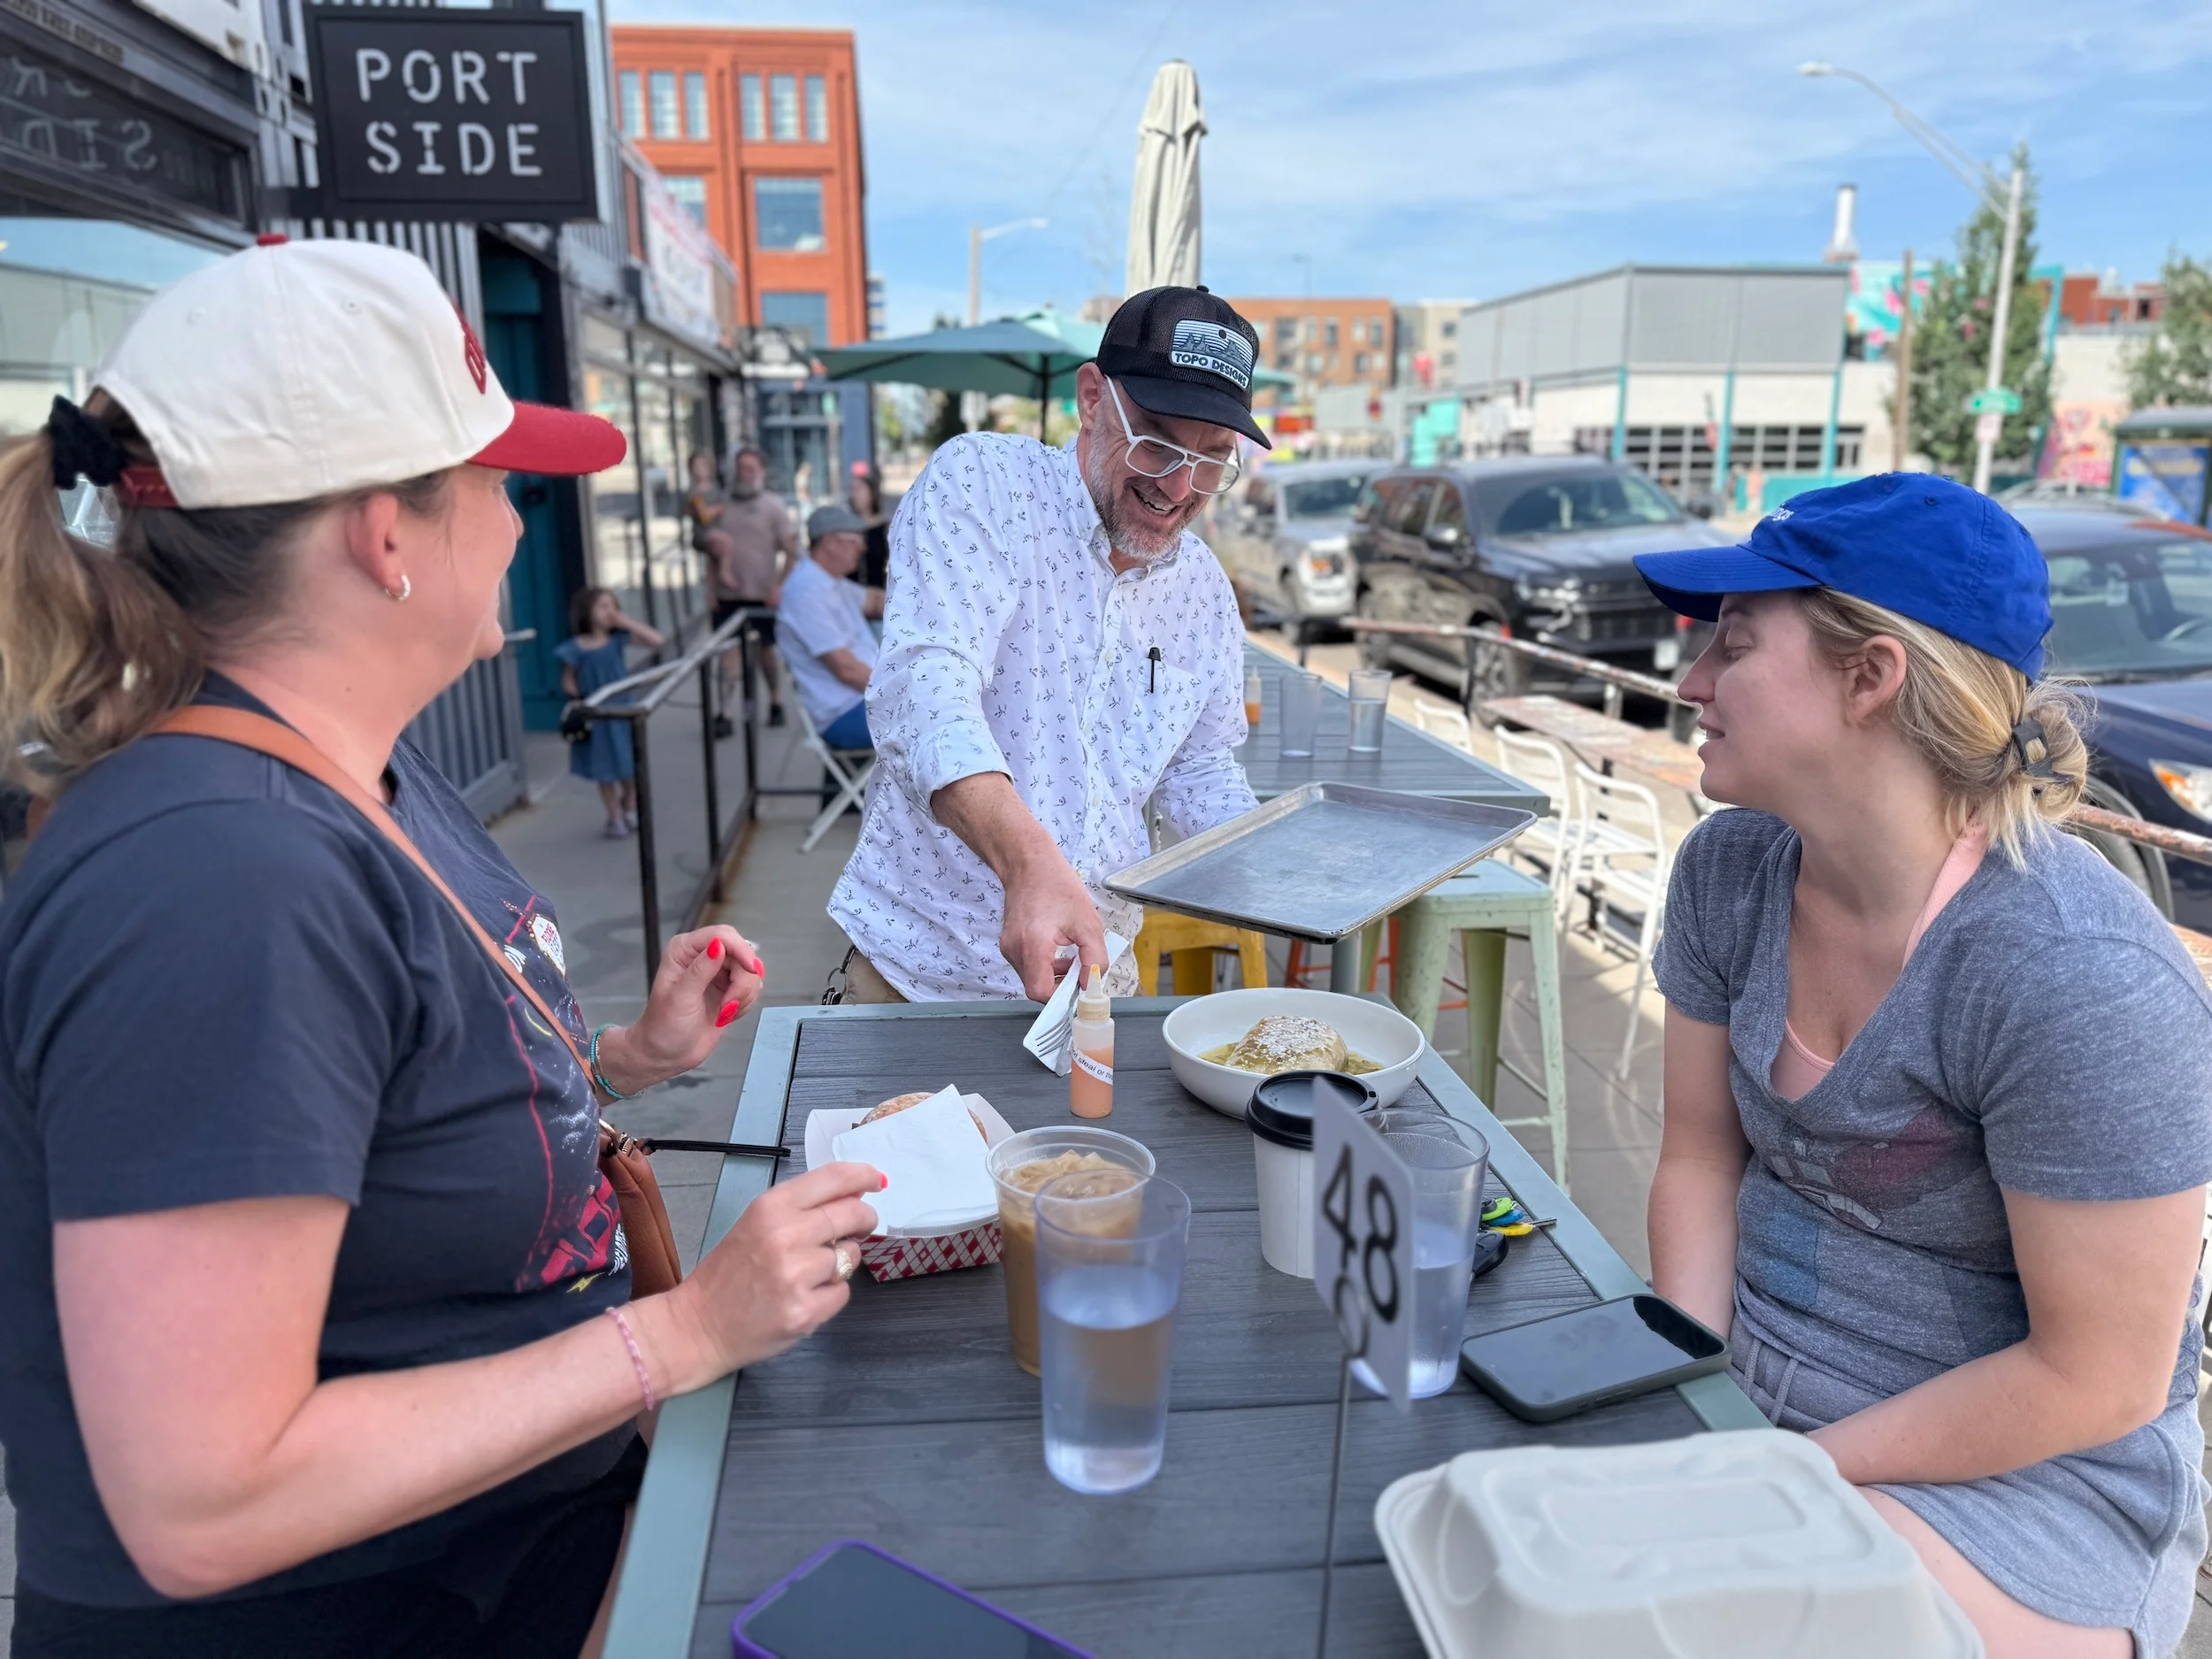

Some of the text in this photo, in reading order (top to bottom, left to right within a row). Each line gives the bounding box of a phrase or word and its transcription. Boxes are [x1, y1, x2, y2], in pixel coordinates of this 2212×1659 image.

[356, 48, 537, 105] PORT
[365, 120, 542, 176] SIDE
[1175, 353, 1247, 387] TOPO DESIGNS
[1078, 1056, 1097, 1072] steal
[1321, 1139, 1400, 1325] 48
